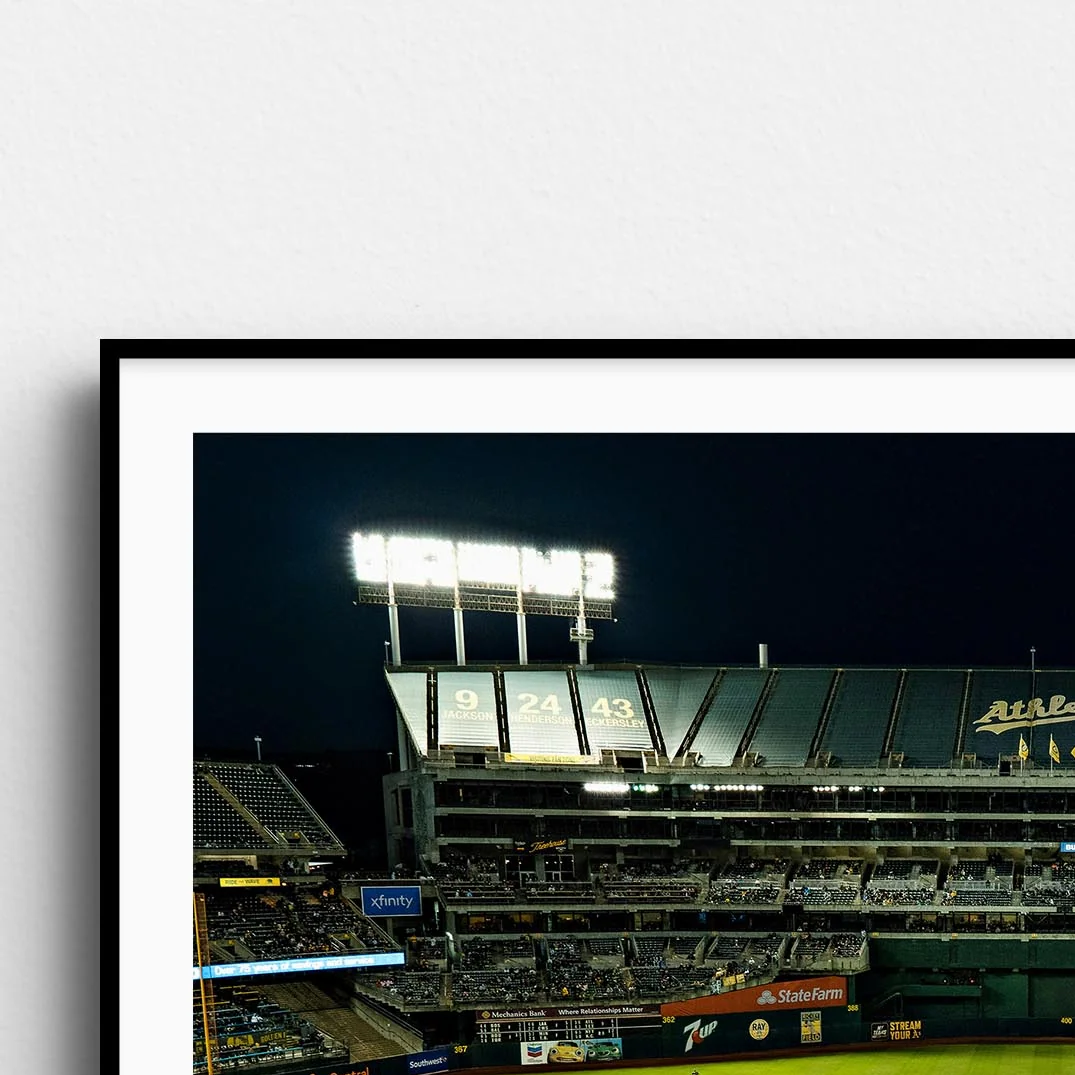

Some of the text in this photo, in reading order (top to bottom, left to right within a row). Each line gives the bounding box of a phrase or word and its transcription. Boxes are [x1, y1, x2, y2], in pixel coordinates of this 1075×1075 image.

[455, 689, 478, 711] 9
[517, 692, 561, 715] 24
[591, 697, 635, 719] 43
[442, 710, 493, 721] JACKSON
[510, 714, 574, 725] HENDERSON
[586, 717, 645, 728] ECKERSLEY
[370, 894, 414, 909] xfinity
[214, 963, 236, 975] Over
[239, 963, 250, 973] 75
[253, 962, 278, 974] years
[491, 1010, 528, 1018] Mechanics
[529, 1009, 546, 1017] Bank
[580, 1007, 622, 1015] Relationships
[662, 1016, 676, 1024] 362
[890, 1020, 921, 1030] STREAM
[752, 1022, 766, 1031] RAY
[890, 1030, 911, 1040] YOUR
[409, 1056, 442, 1068] Southwest
